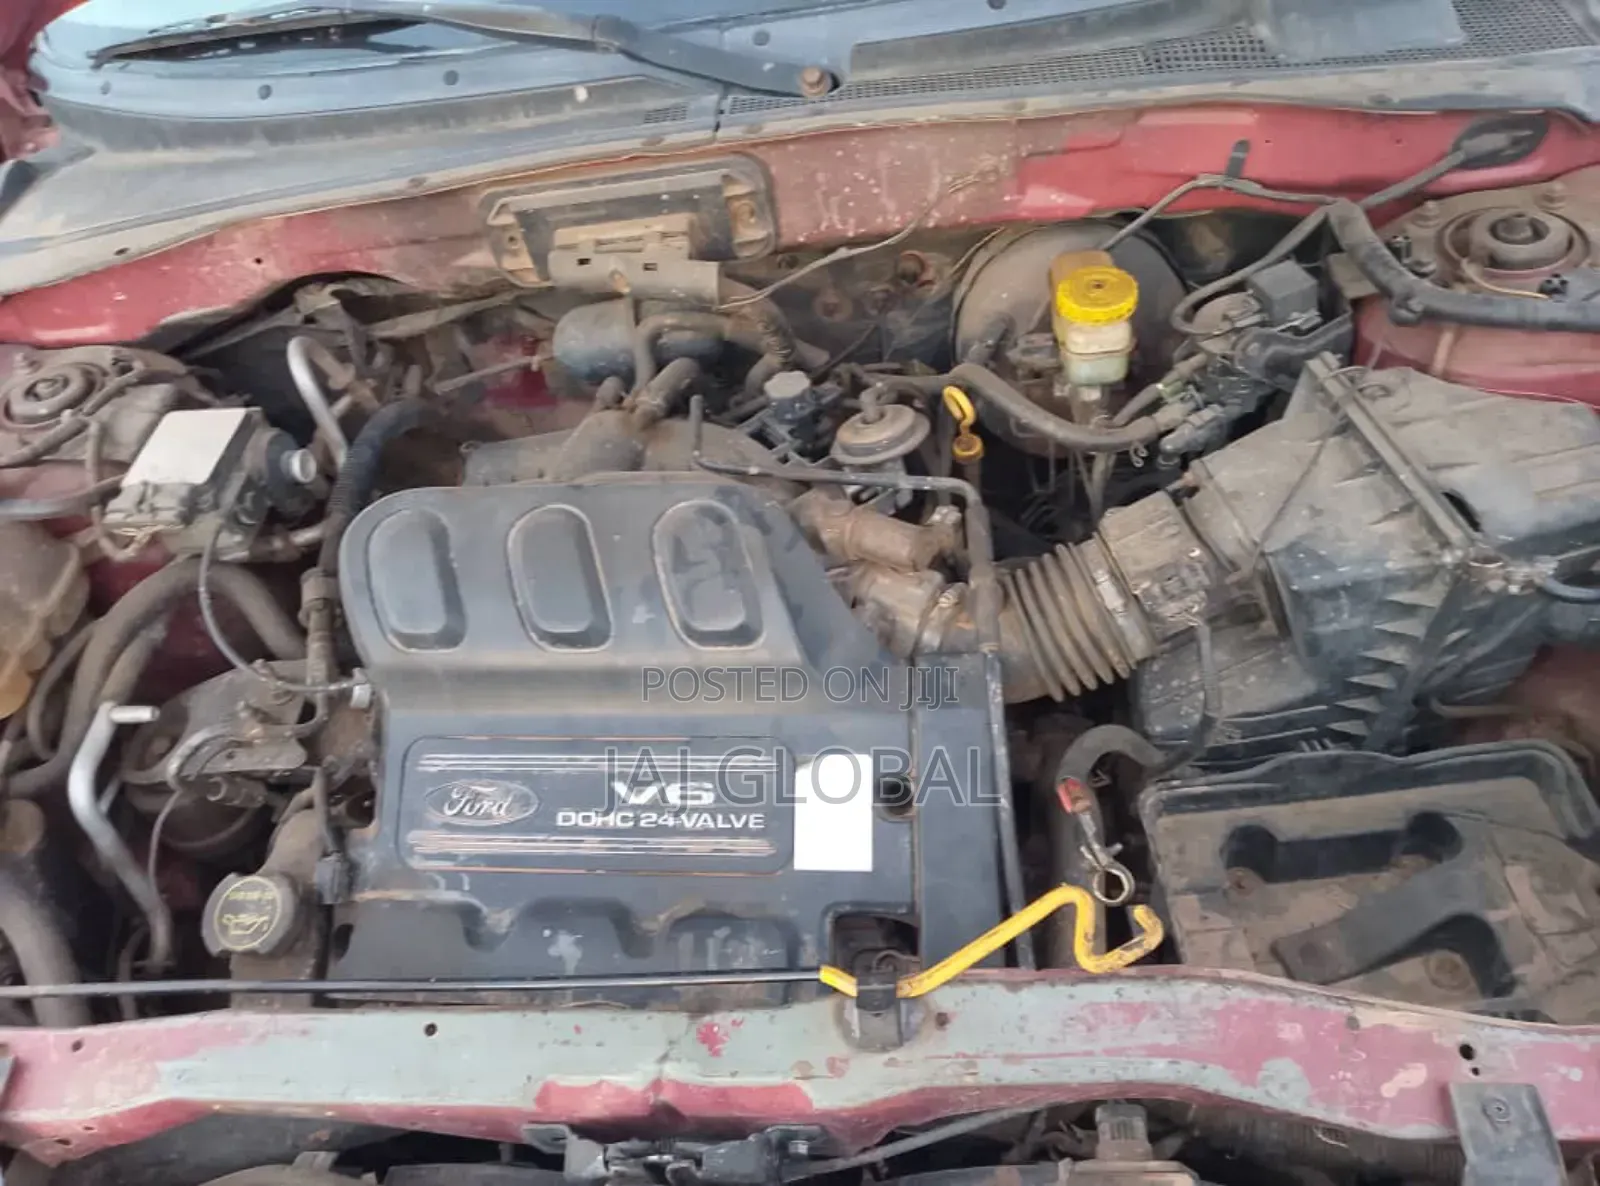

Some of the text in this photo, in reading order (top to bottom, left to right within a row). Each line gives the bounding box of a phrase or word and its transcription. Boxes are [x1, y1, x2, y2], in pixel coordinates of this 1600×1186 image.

[443, 783, 514, 817] Ford
[611, 781, 715, 806] V6
[556, 811, 634, 828] DOHC
